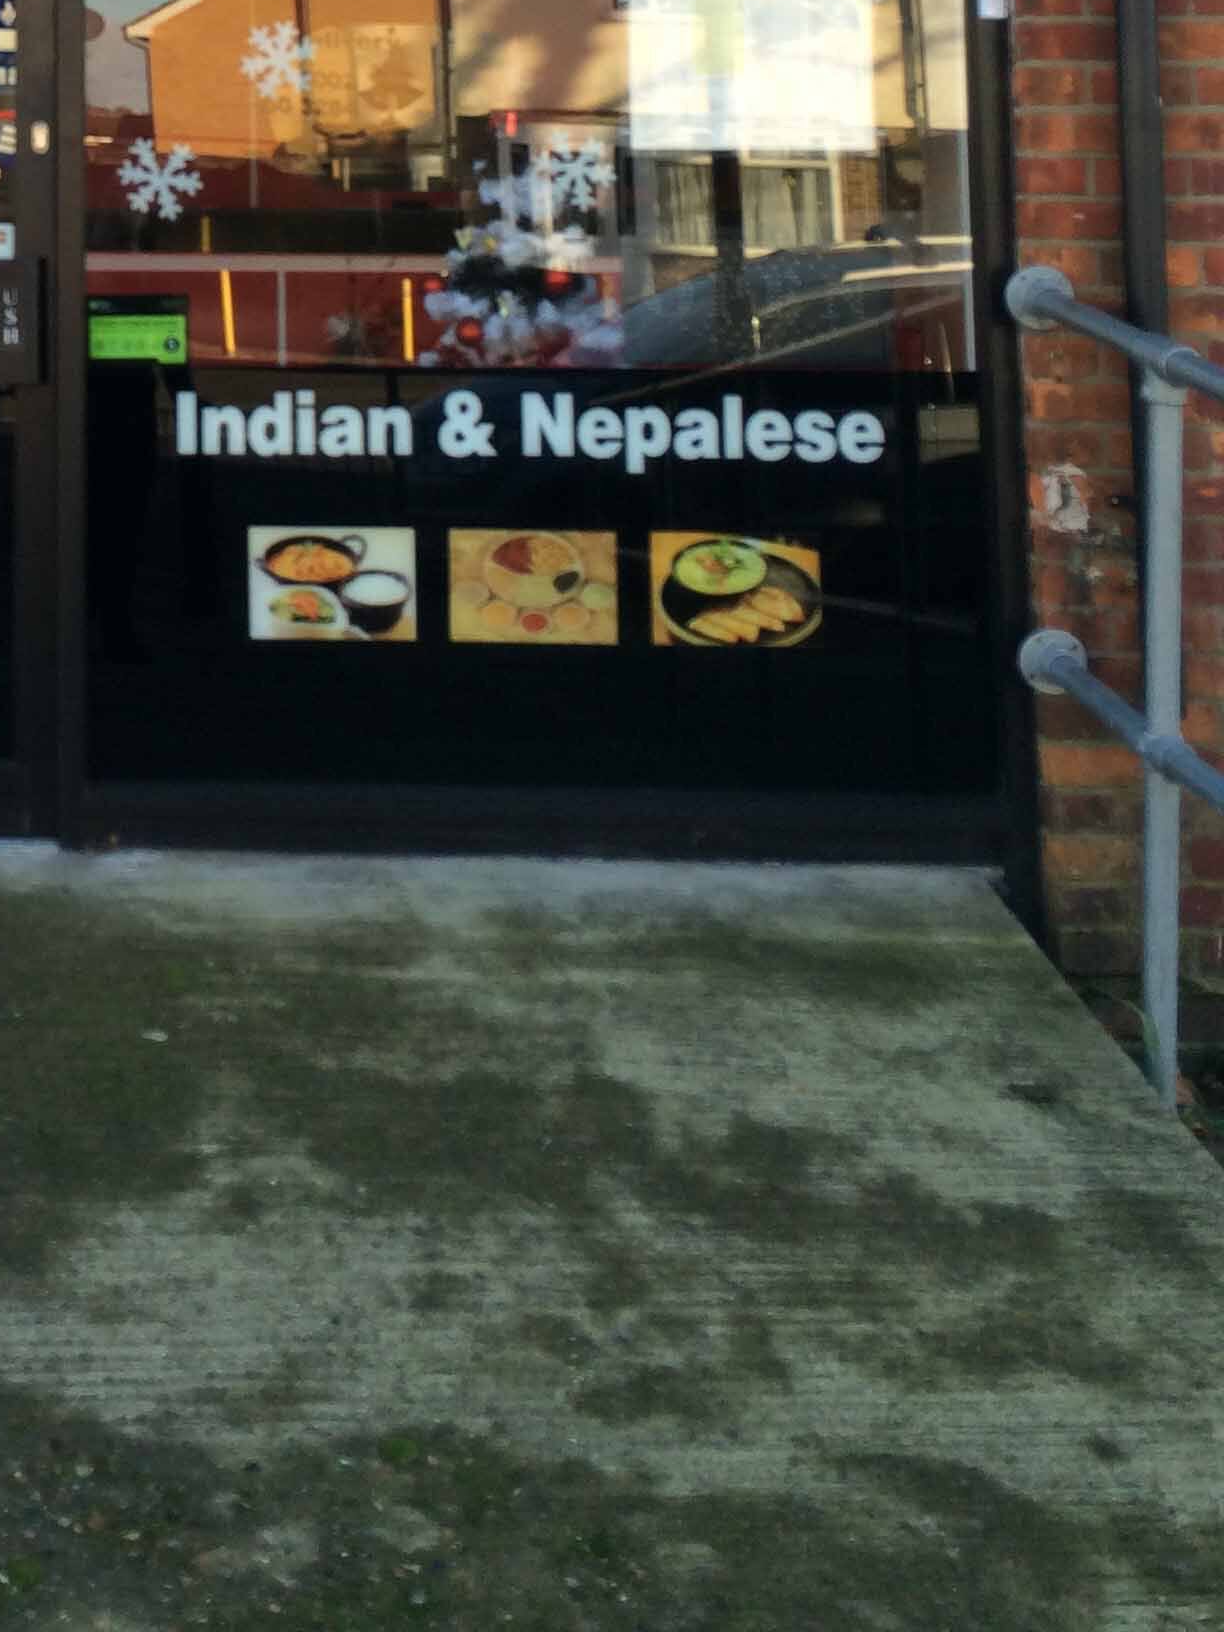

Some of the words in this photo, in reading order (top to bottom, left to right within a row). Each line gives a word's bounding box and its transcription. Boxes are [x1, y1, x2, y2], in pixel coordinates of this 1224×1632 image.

[176, 390, 413, 458] Indian
[437, 390, 498, 460] &
[521, 392, 886, 475] Nepalese
